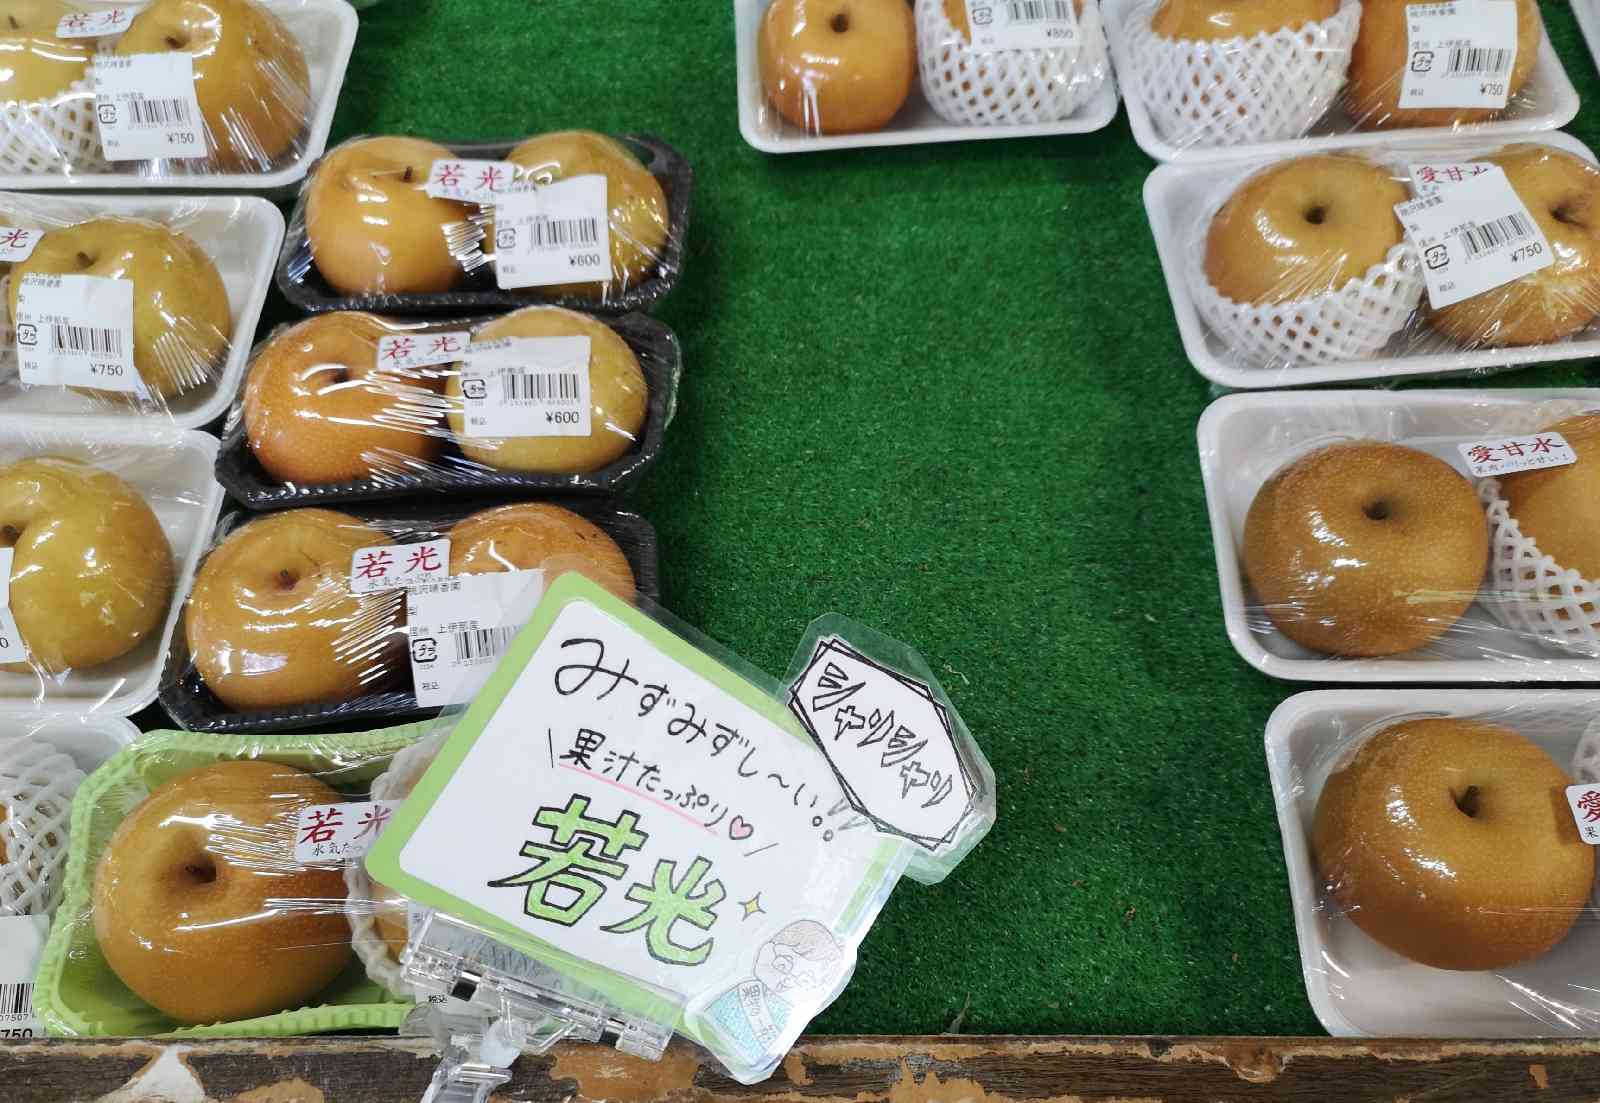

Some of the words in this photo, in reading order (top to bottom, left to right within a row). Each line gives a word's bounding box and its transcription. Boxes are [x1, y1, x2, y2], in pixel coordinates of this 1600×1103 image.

[166, 132, 195, 145] ¥750
[434, 164, 505, 192] 若光
[0, 228, 29, 249] 光
[568, 253, 601, 267] ¥600
[1511, 241, 1543, 263] ¥750
[382, 335, 462, 360] 若光
[89, 362, 124, 377] ¥750
[544, 411, 580, 424] ¥600
[1467, 437, 1565, 464] 愛甘水
[355, 545, 442, 580] 若光
[811, 661, 954, 810] シャリシャリ
[558, 727, 729, 829] 果汁たっぷり
[486, 792, 728, 967] 若光
